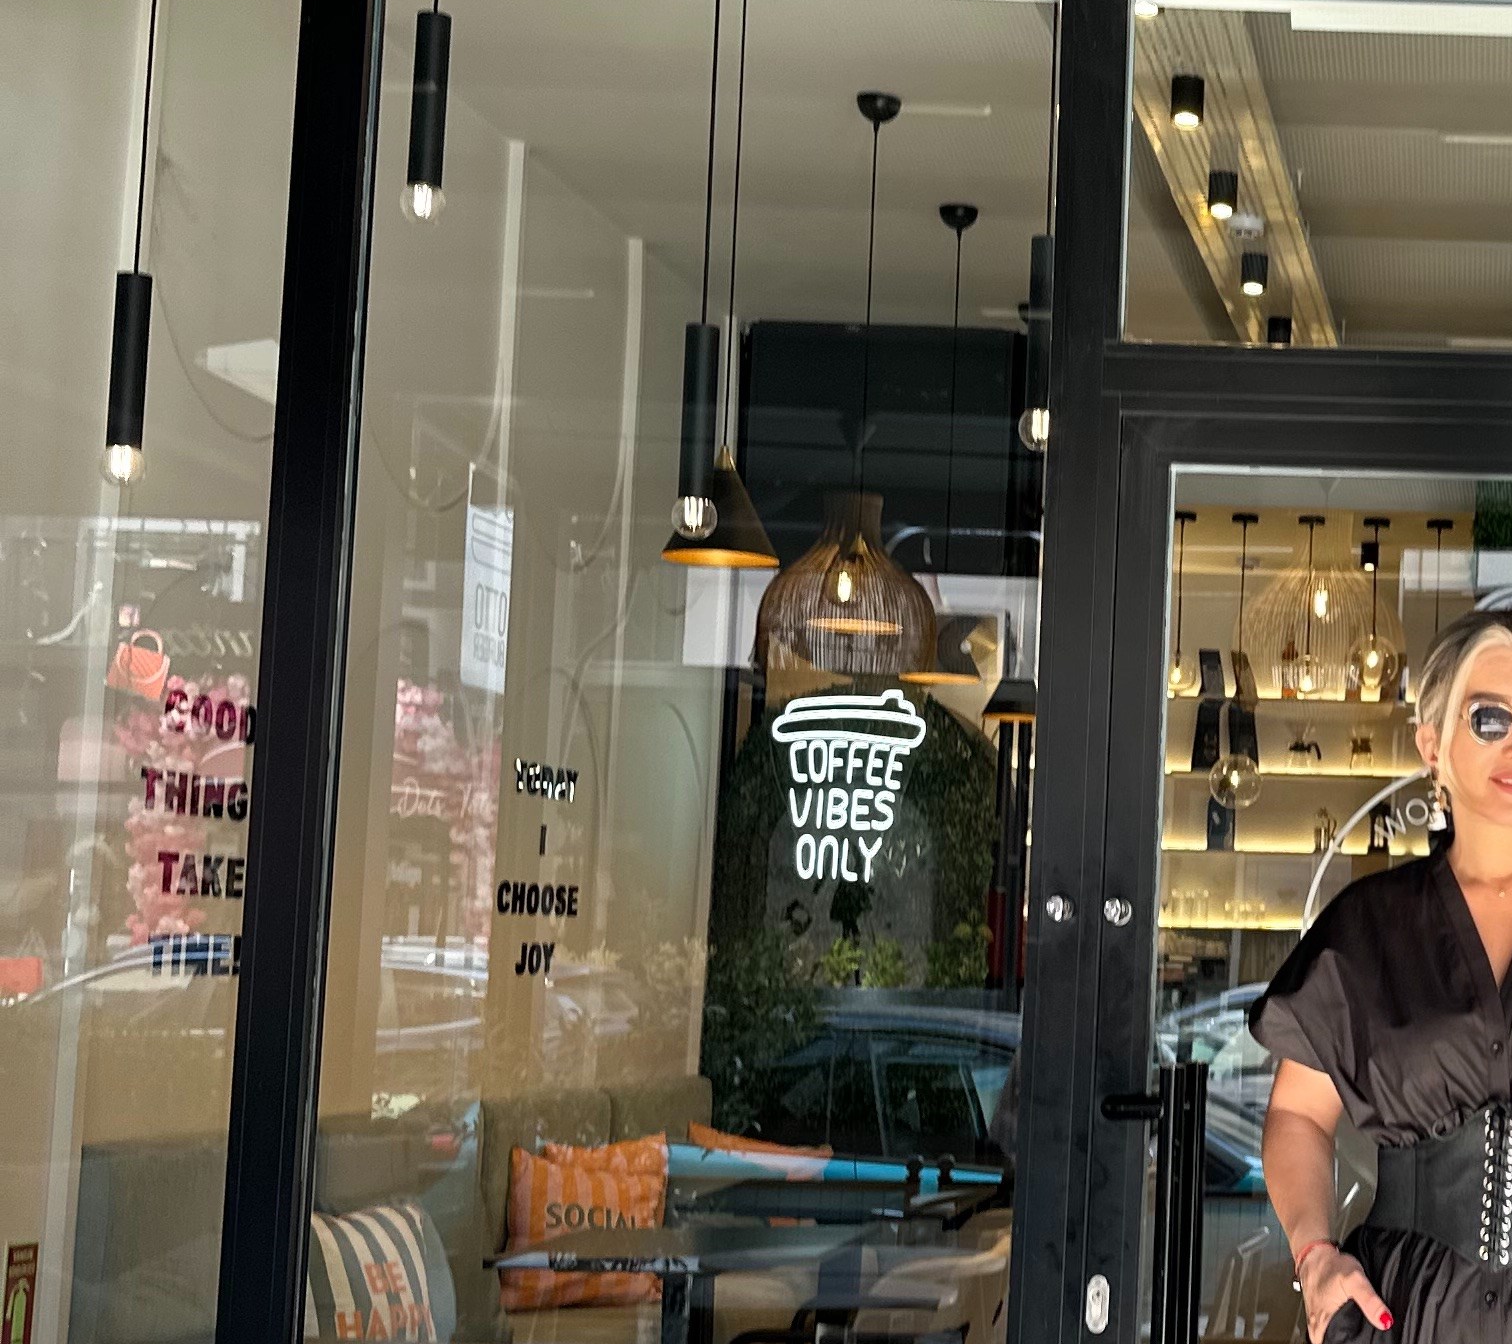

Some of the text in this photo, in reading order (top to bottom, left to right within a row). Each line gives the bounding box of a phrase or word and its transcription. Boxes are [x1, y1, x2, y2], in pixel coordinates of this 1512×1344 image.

[788, 739, 911, 789] COFFEE
[788, 787, 894, 831] VIBES
[539, 824, 547, 856] I
[795, 834, 883, 883] ONLY
[156, 851, 246, 899] TAKE
[496, 879, 578, 917] CHOOSE
[515, 942, 555, 976] JOY
[364, 1261, 406, 1293] BE
